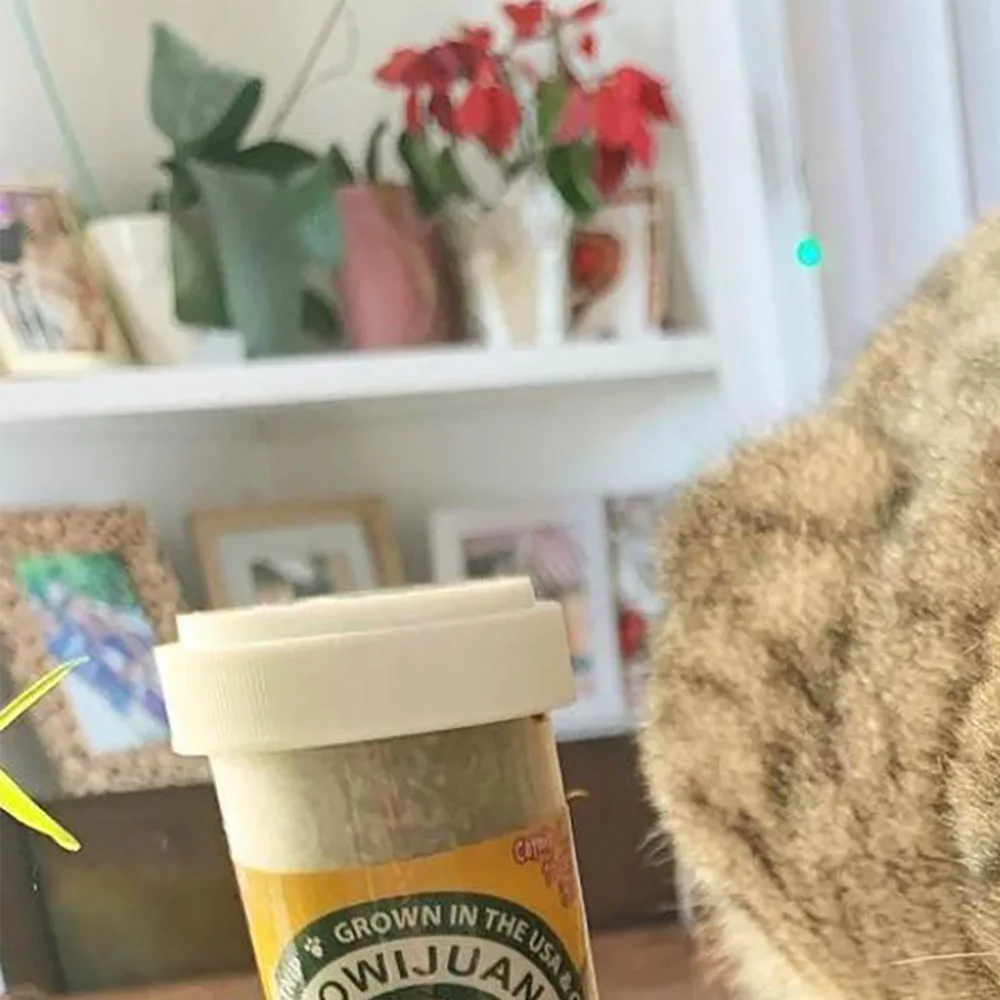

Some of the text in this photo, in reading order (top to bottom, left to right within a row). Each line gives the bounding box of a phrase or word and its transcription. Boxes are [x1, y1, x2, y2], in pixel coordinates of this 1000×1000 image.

[333, 904, 442, 945] GROWN
[450, 904, 479, 928] IN
[485, 906, 530, 942] THE
[529, 929, 564, 976] USA
